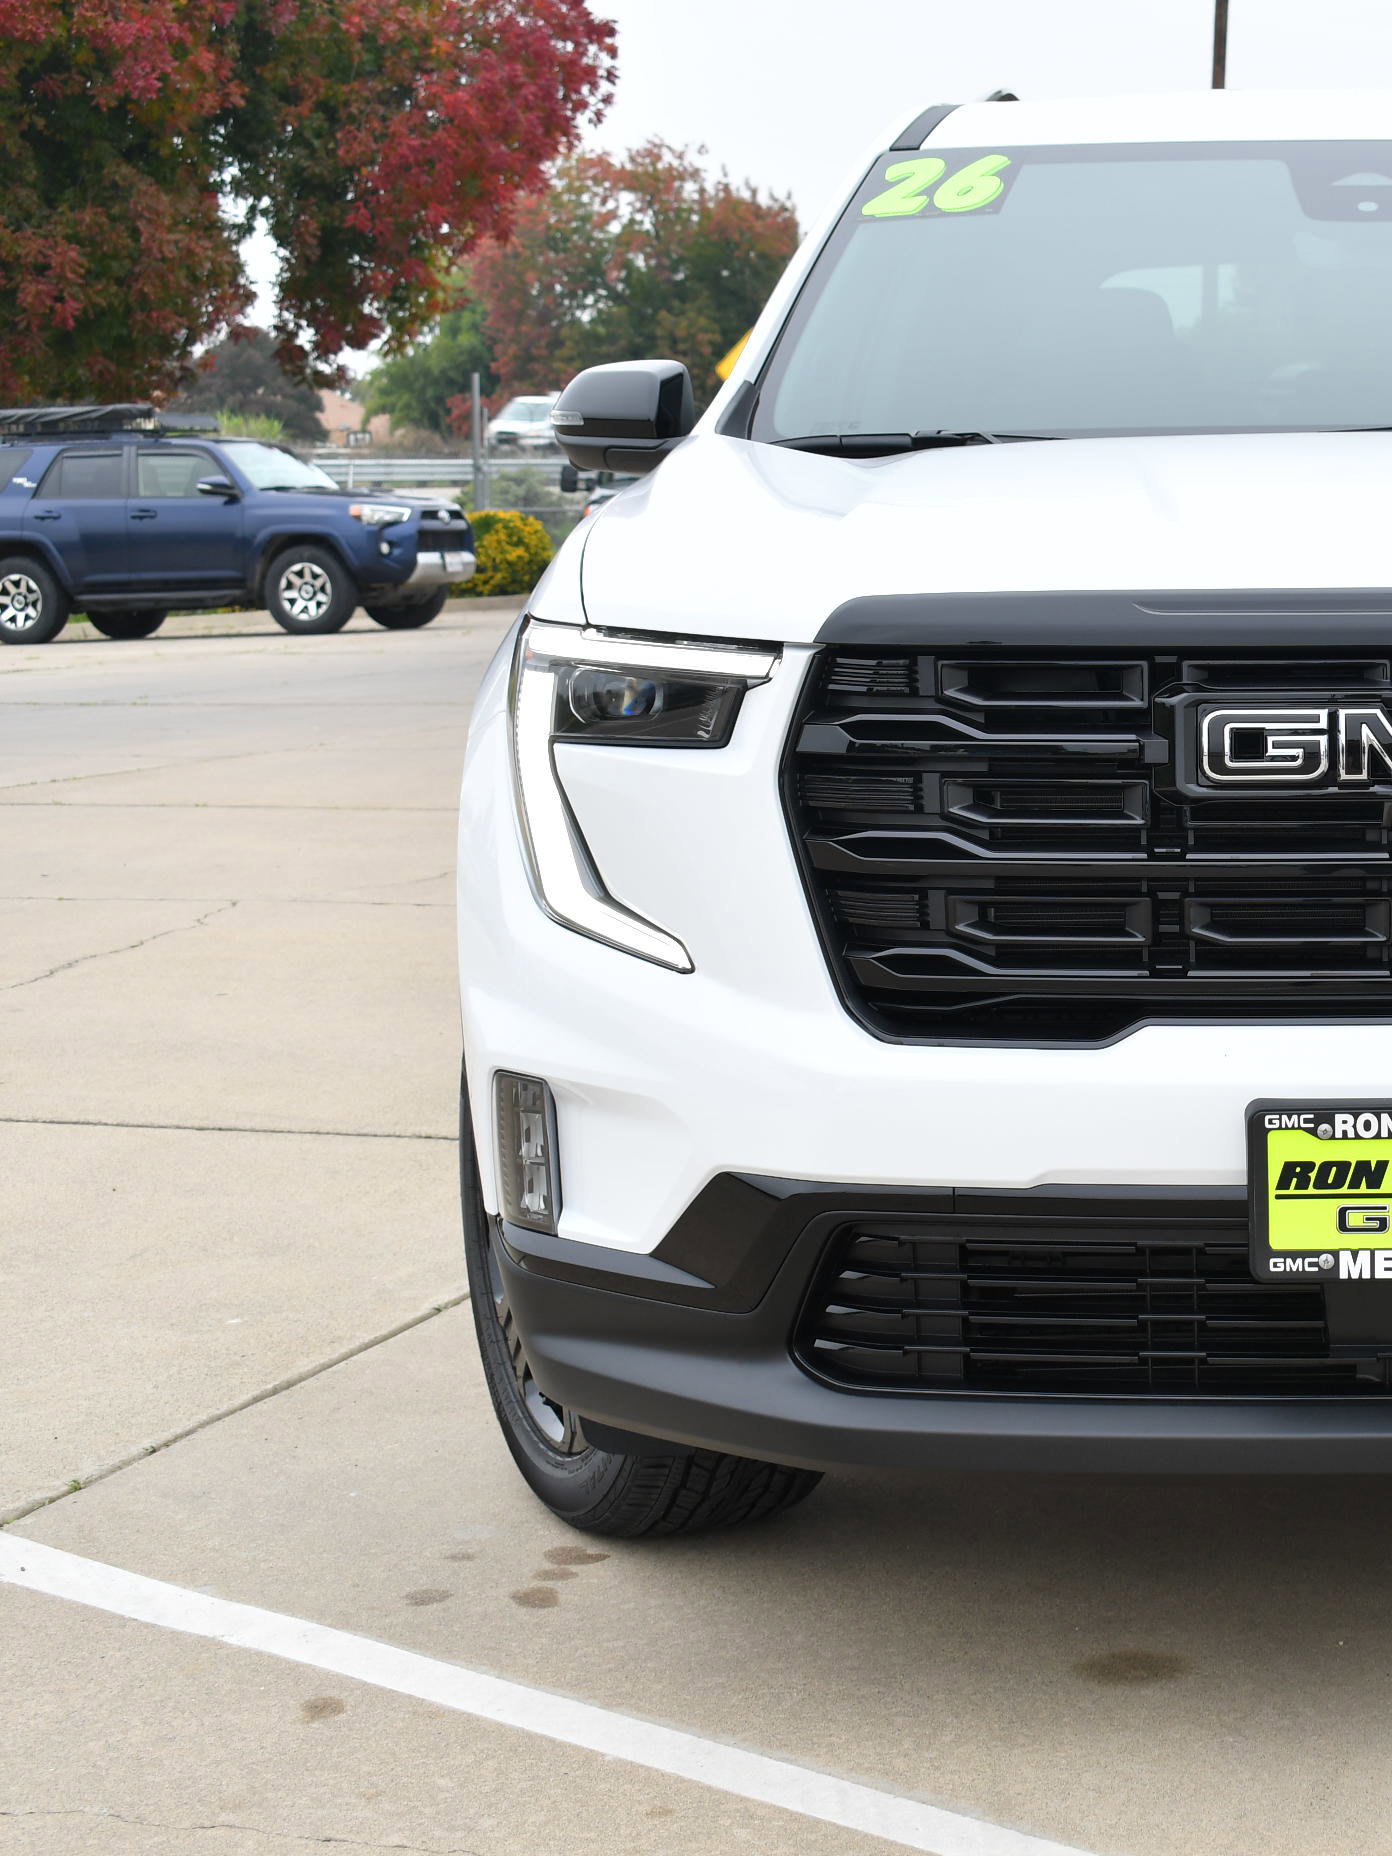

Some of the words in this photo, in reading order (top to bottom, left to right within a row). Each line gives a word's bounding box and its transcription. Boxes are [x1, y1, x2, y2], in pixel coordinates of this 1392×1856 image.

[861, 154, 1012, 217] 26
[1264, 1114, 1314, 1129] GMC
[1275, 1160, 1390, 1191] RON
[1269, 1257, 1320, 1272] GMC
